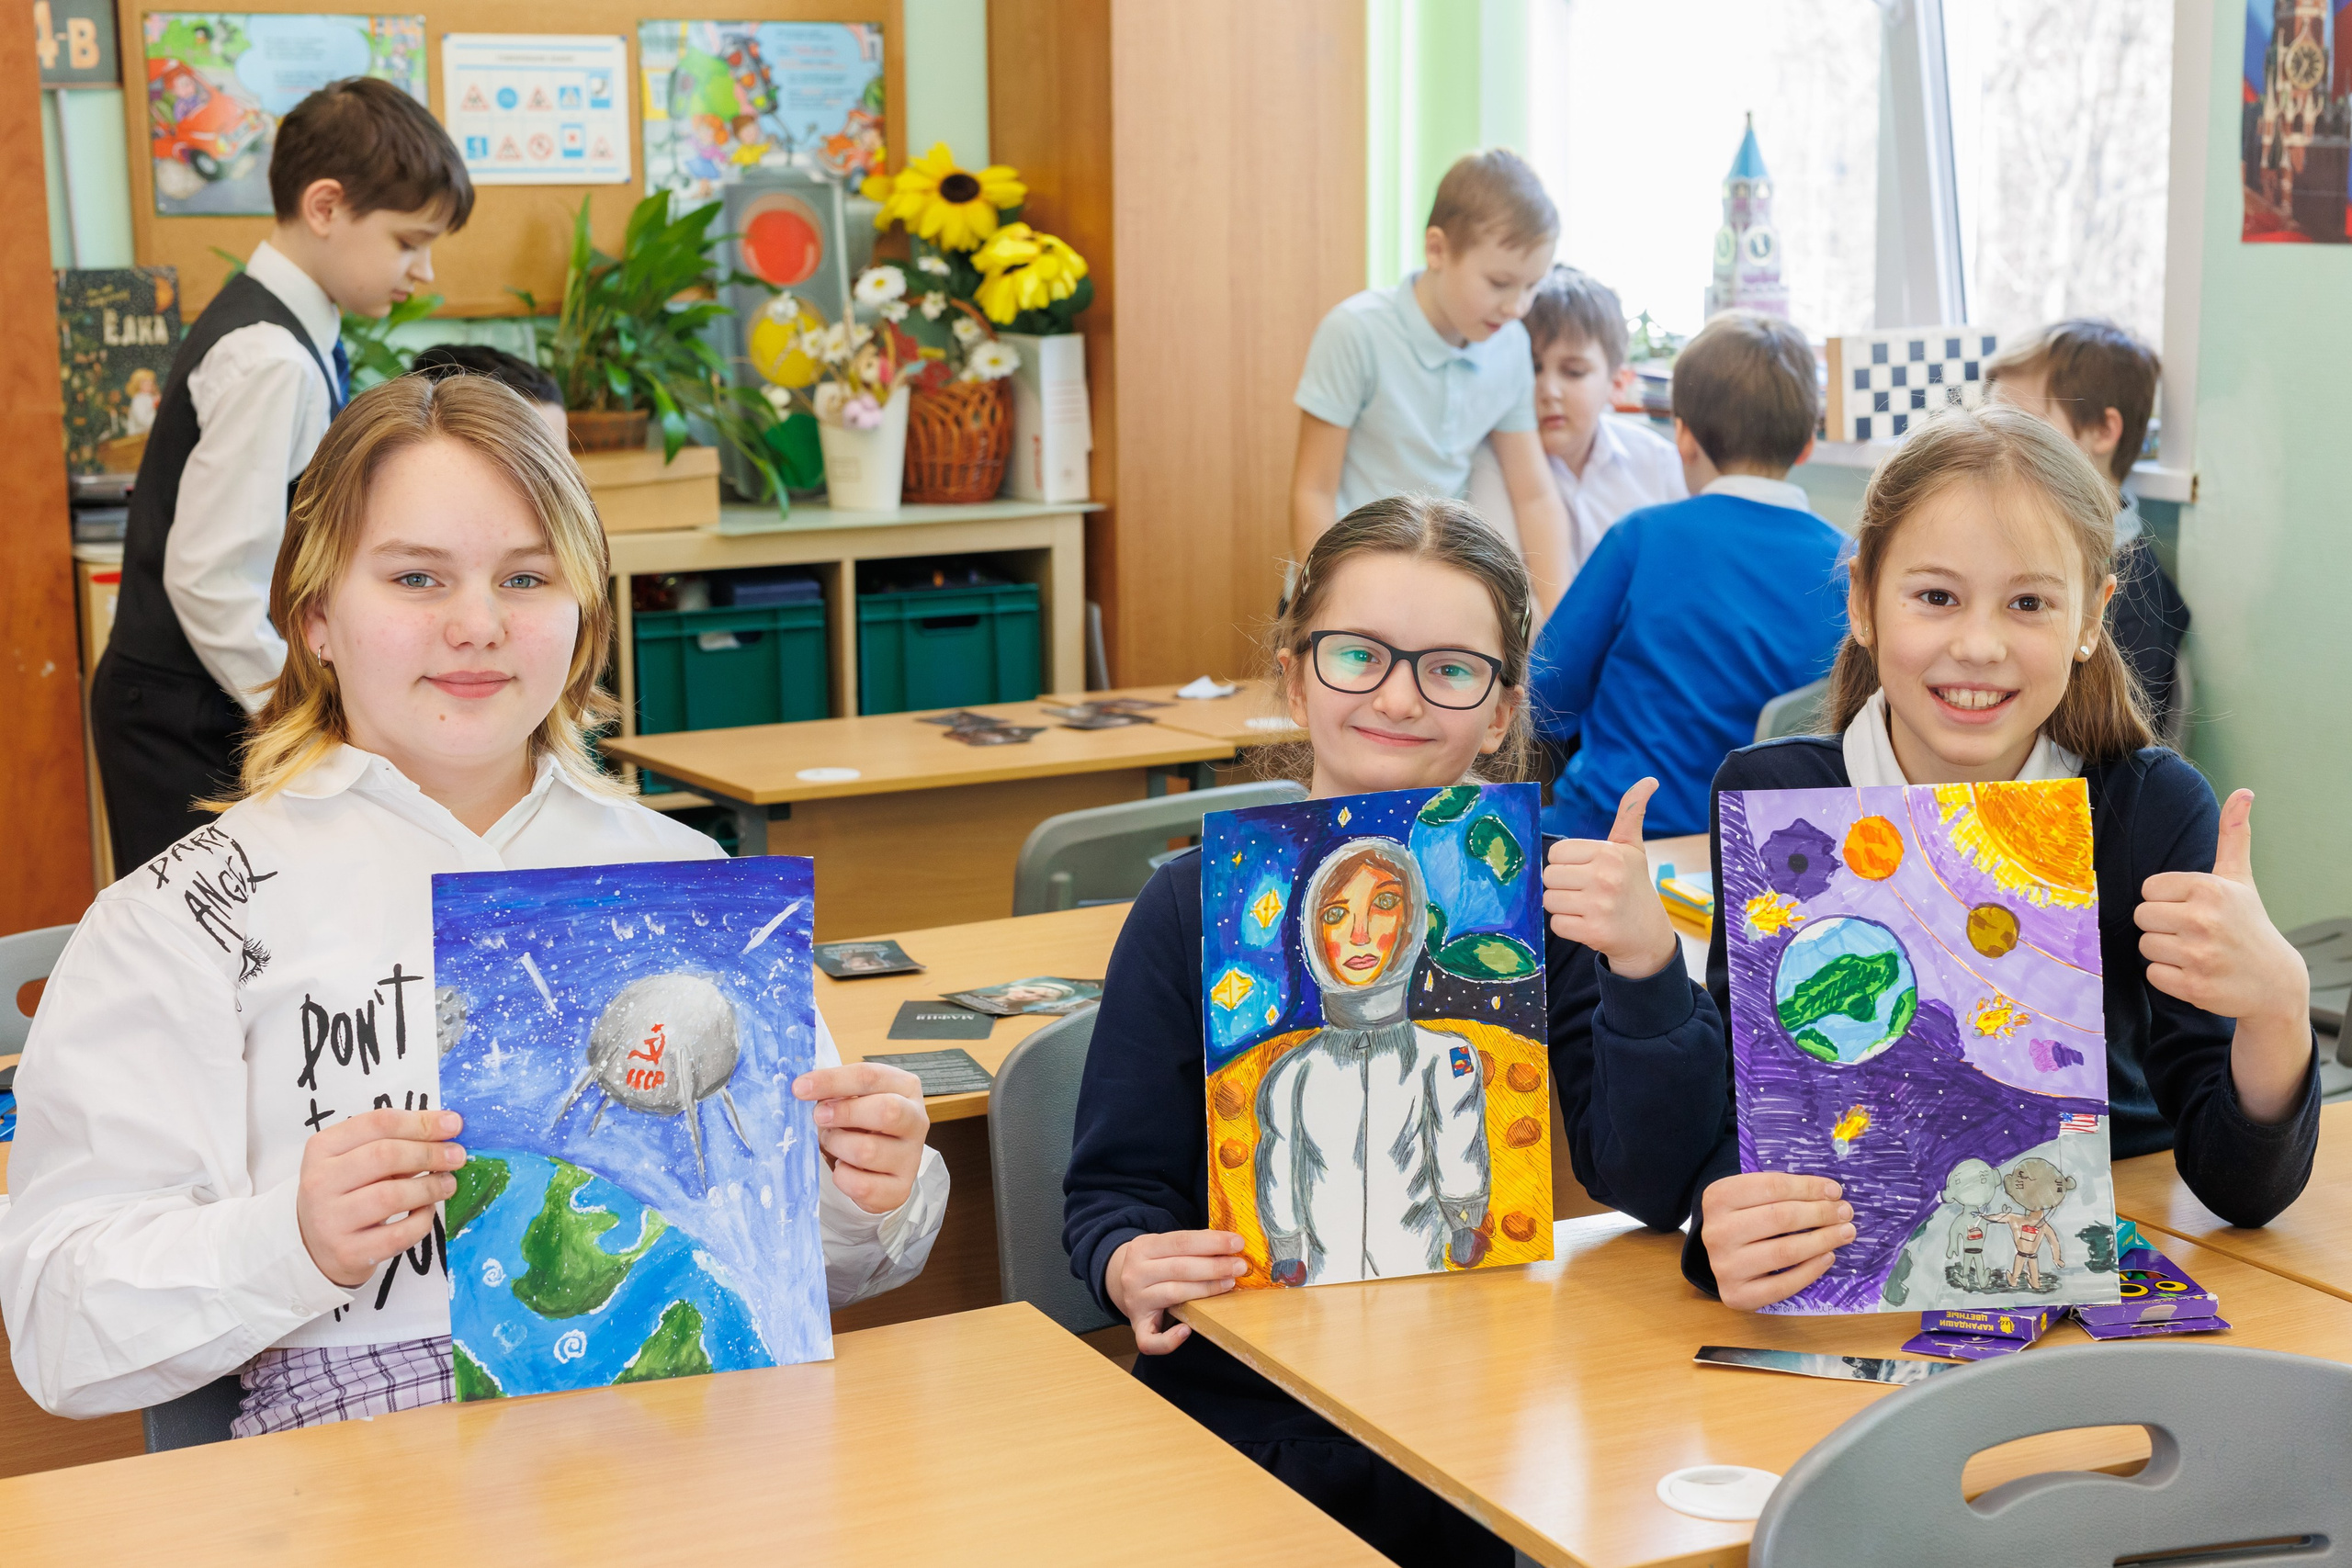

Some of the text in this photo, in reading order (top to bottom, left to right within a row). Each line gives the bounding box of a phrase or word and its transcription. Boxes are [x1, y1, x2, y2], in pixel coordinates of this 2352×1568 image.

[146, 821, 230, 889] DARK
[297, 963, 424, 1091] DON'T
[626, 1068, 665, 1090] СССР
[1939, 1319, 1995, 1331] КАРАНДАШИ
[1946, 1311, 1988, 1322] ЦВЕТНЫЕ
